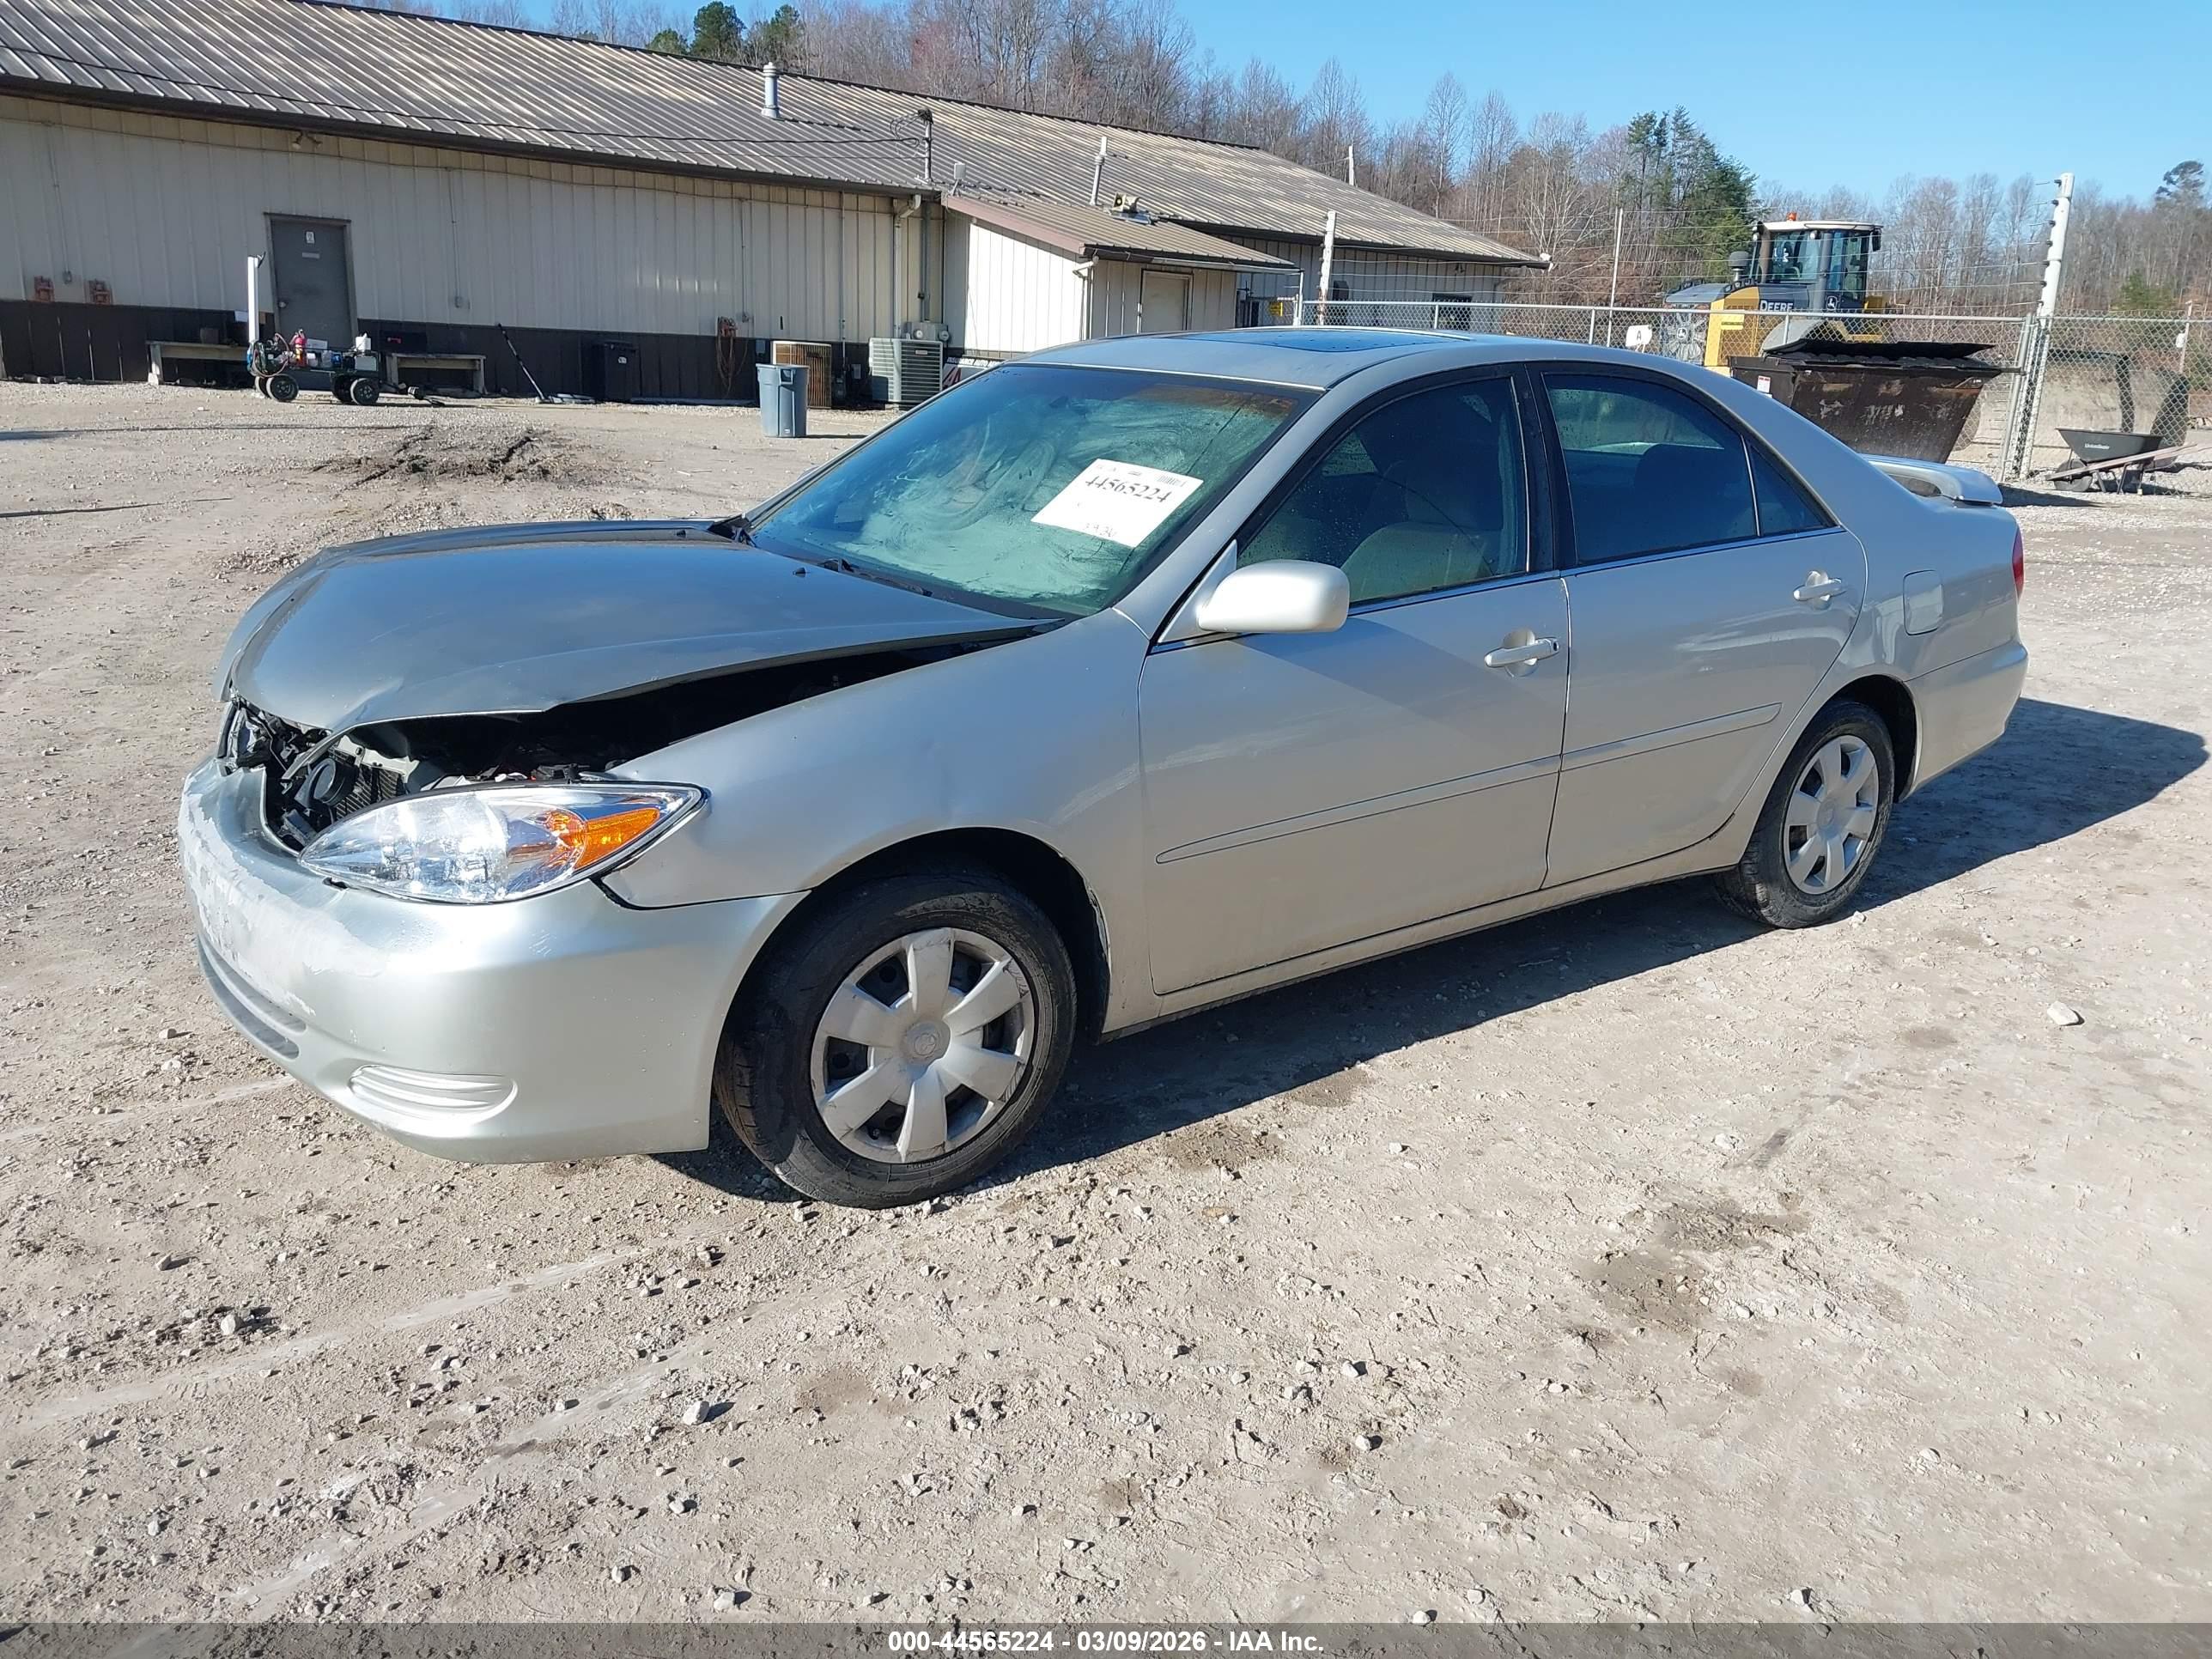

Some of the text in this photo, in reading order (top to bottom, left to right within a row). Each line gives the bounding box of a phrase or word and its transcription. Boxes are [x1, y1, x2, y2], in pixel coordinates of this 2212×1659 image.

[1760, 300, 1794, 312] DEERE
[1636, 330, 1642, 341] A
[1085, 476, 1172, 502] 44565224
